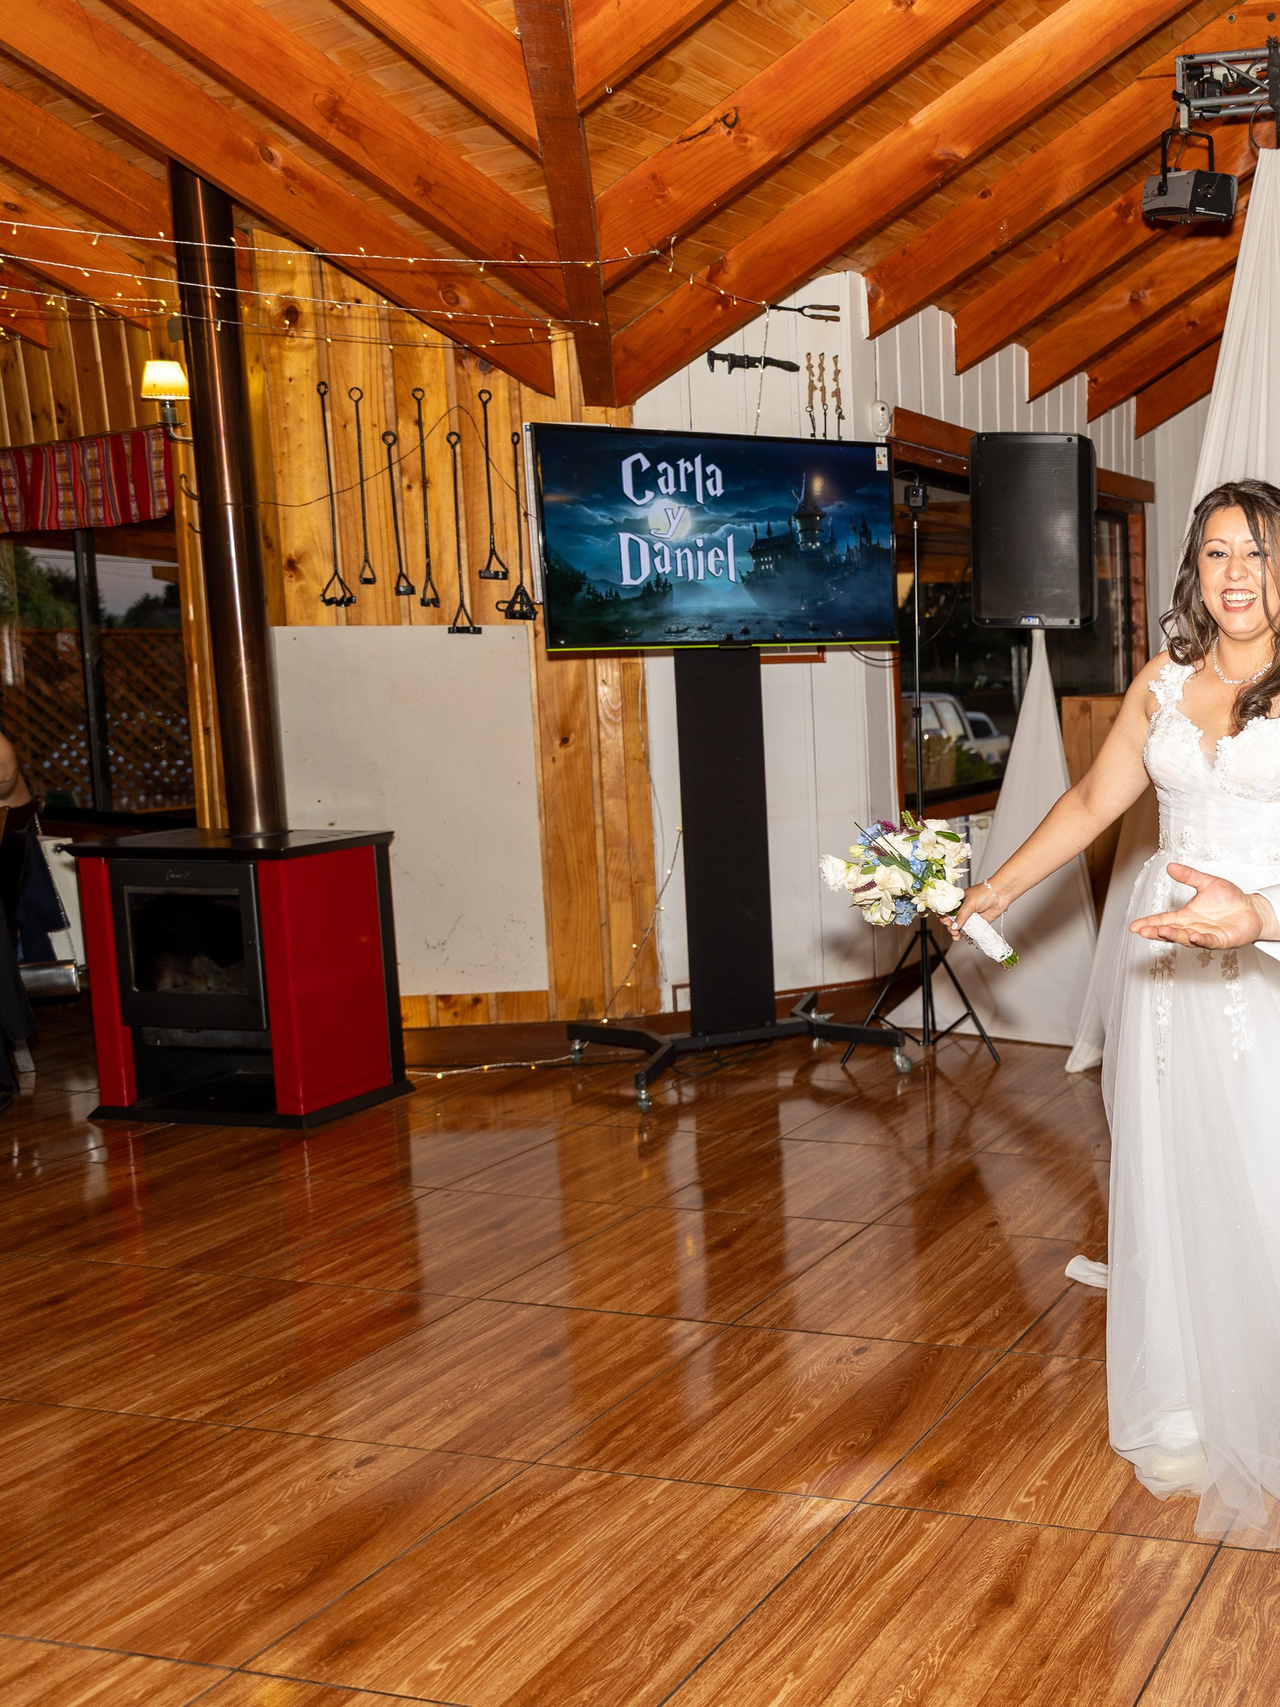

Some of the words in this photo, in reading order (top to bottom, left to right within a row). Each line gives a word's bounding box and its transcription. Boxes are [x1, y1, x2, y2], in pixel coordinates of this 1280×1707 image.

[621, 452, 725, 506] Carla
[649, 506, 687, 539] y
[618, 532, 737, 586] Daniel
